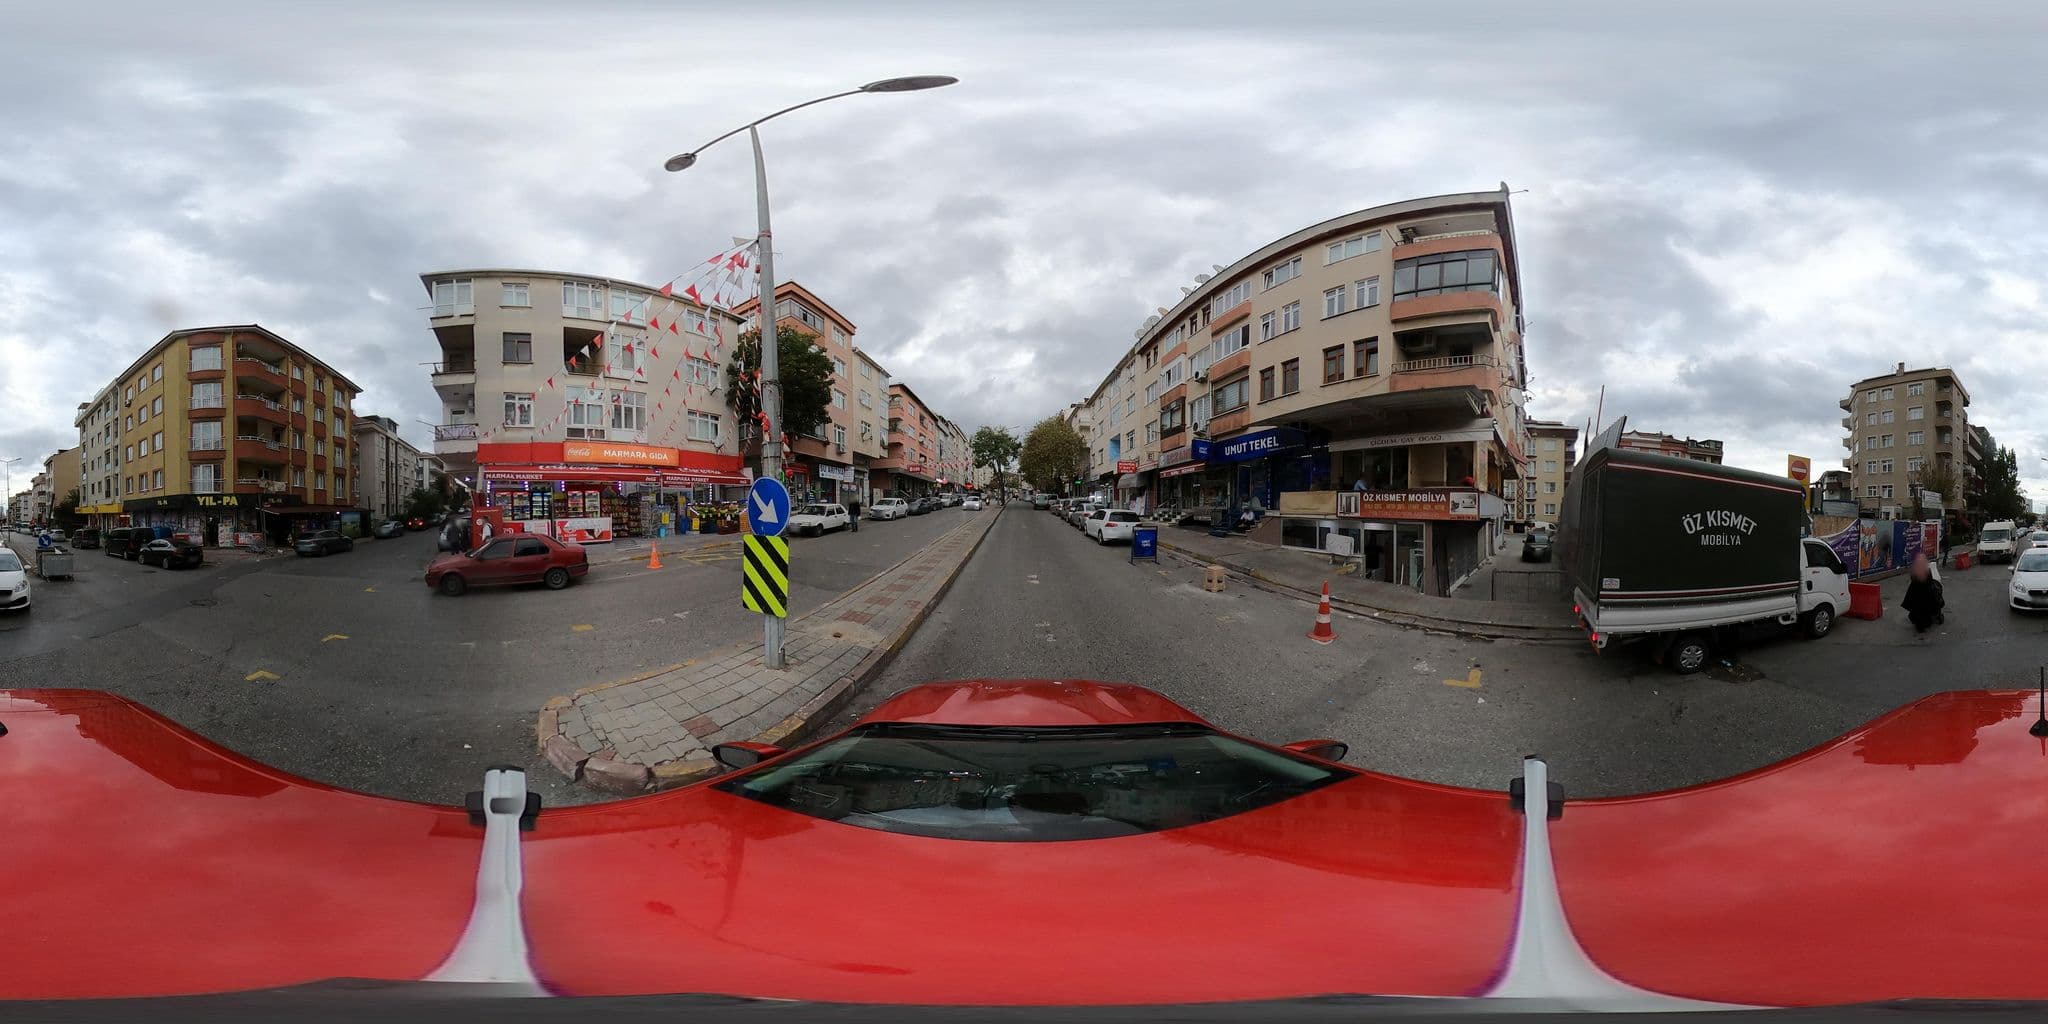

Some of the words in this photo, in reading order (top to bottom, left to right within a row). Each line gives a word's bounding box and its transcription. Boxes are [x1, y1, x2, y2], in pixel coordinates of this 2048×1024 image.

[1225, 442, 1247, 456] UMUT
[1249, 436, 1279, 451] TEKEL
[604, 449, 647, 460] MARMARA
[649, 452, 668, 461] GIDA
[196, 495, 239, 506] YIL-PA
[1363, 492, 1375, 502] ÖZ
[1375, 493, 1406, 502] KISMET
[1408, 491, 1447, 502] MOBİLYA
[1682, 513, 1705, 534] ÖZ
[1706, 510, 1758, 535] KISMET
[1701, 533, 1741, 546] MOBİLYA
